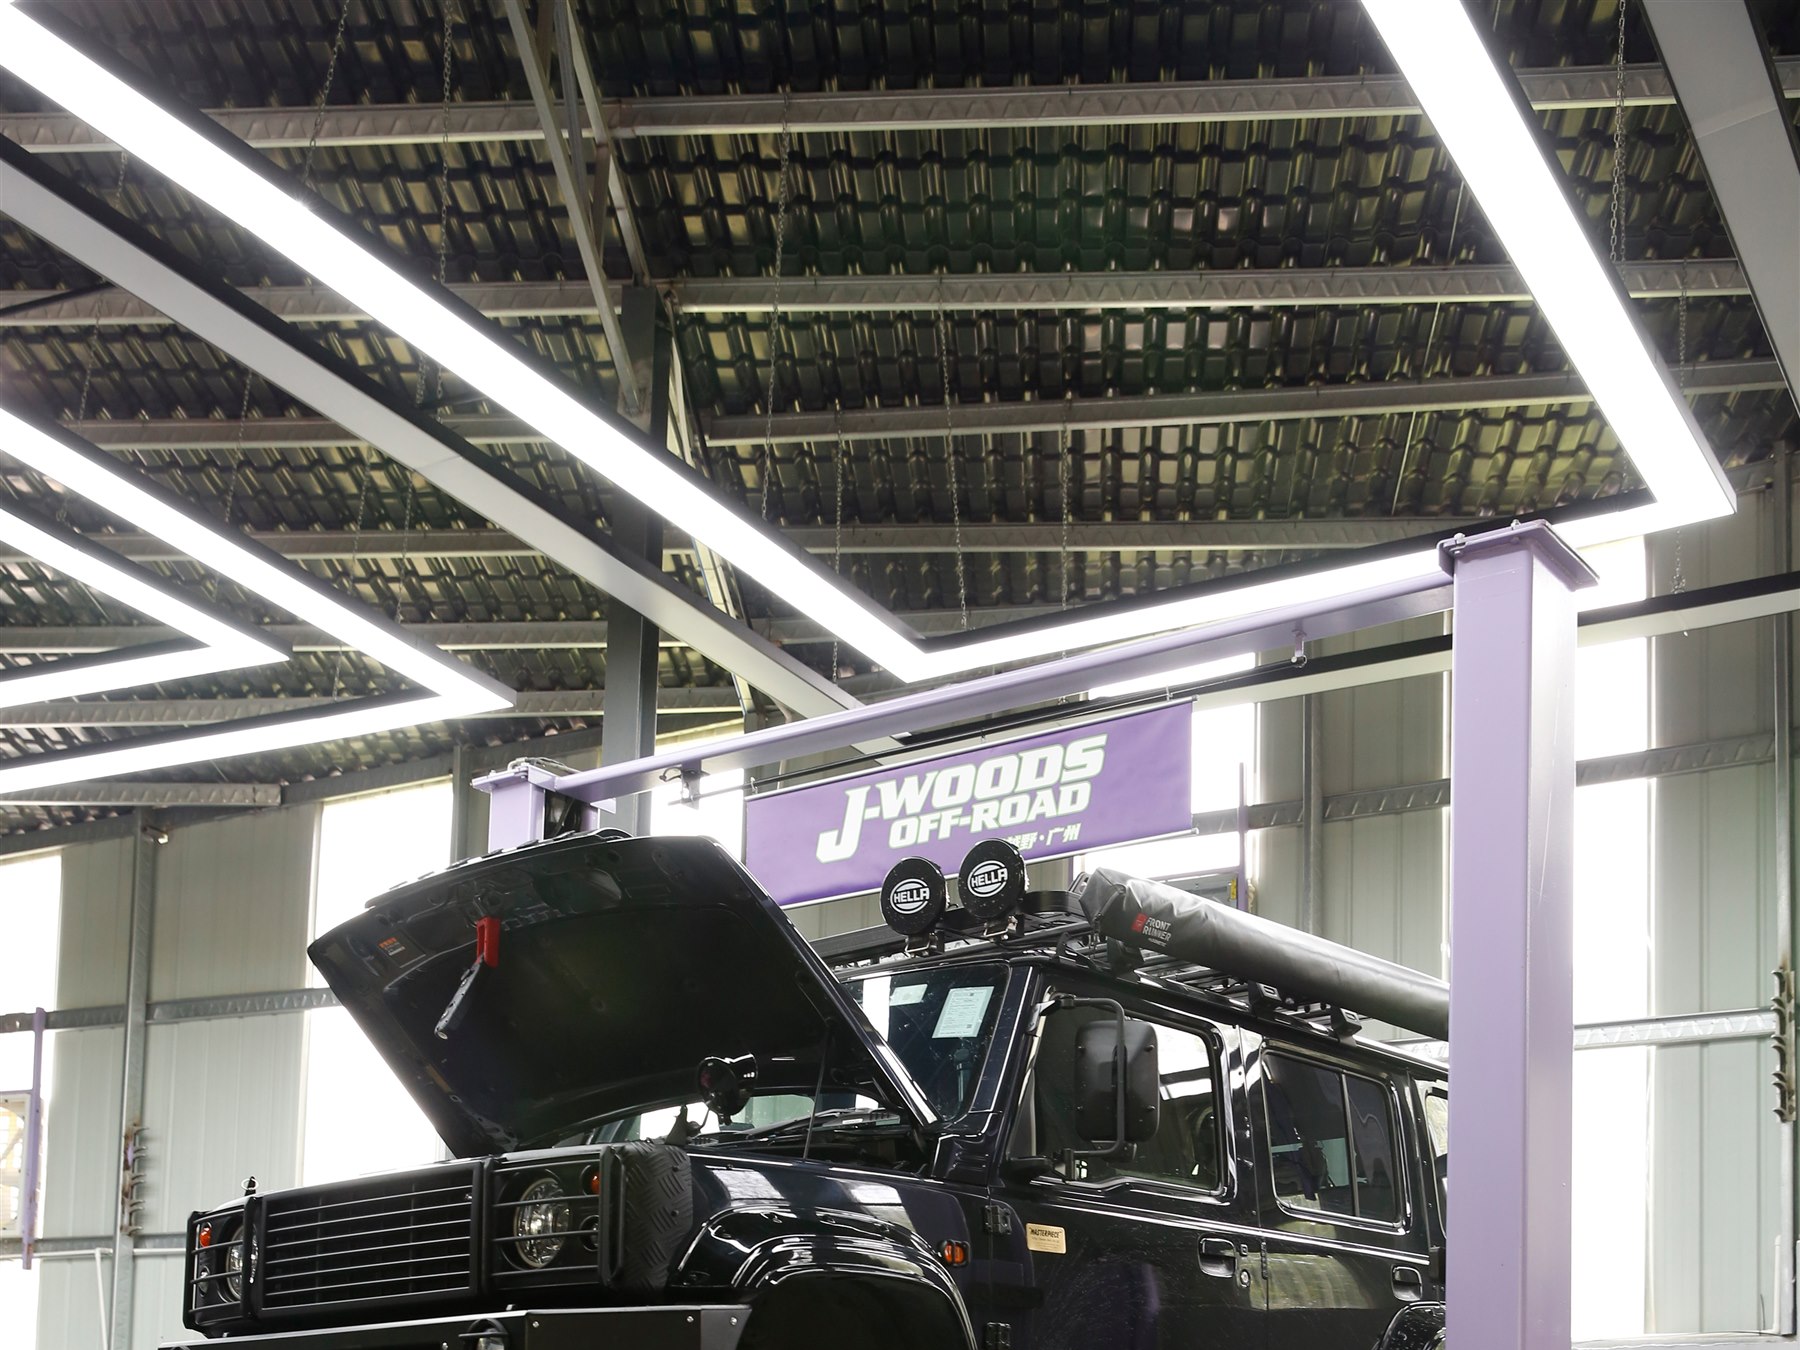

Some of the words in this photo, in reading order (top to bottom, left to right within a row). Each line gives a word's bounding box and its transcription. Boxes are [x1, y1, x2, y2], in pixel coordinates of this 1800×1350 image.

[816, 734, 1107, 863] J-WOODS
[889, 782, 1090, 848] OFF-ROAD
[971, 868, 1008, 888] HELLA
[894, 887, 930, 904] HELLA
[1146, 917, 1171, 931] FRONT
[1142, 925, 1172, 942] RUNNER
